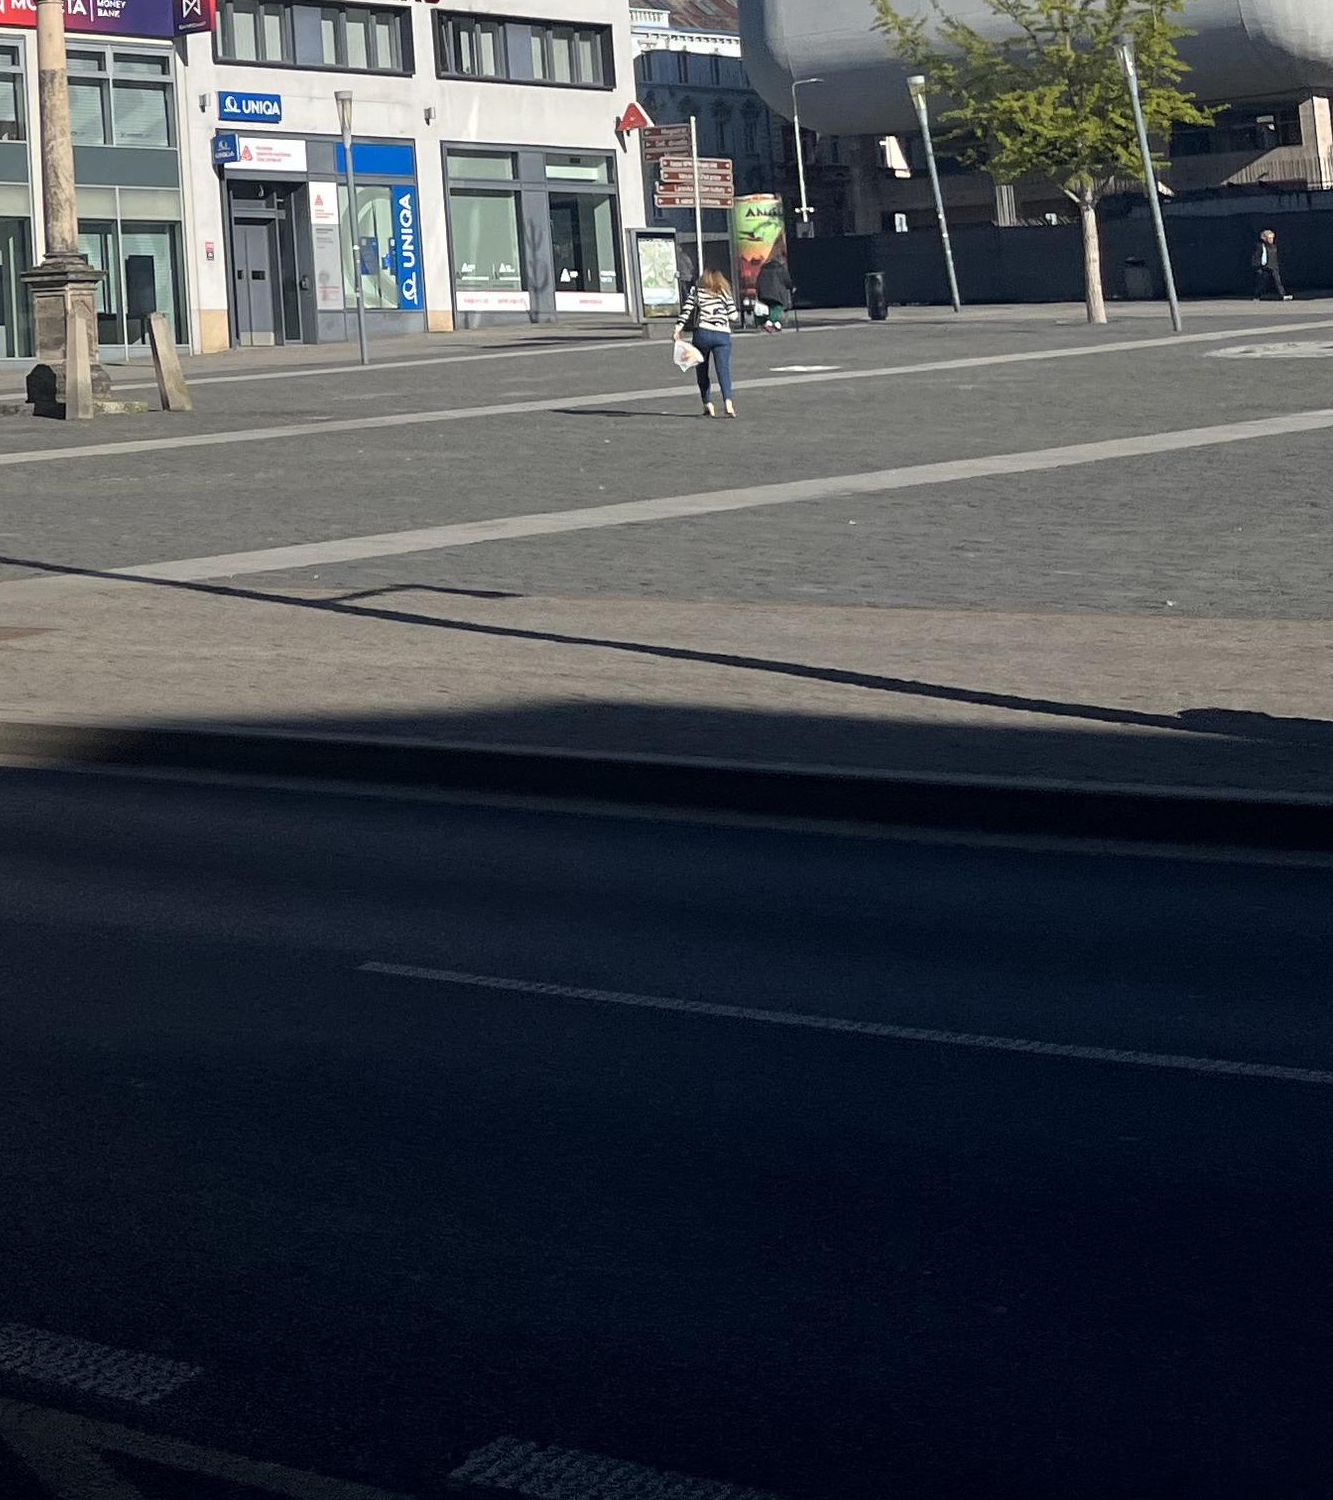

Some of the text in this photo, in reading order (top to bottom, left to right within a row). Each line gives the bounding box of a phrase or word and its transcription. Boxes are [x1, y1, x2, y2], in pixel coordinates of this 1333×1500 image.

[96, 0, 126, 9] MONEY
[96, 8, 121, 18] BANK
[242, 100, 281, 115] UNIQA
[399, 193, 416, 268] UNIQA
